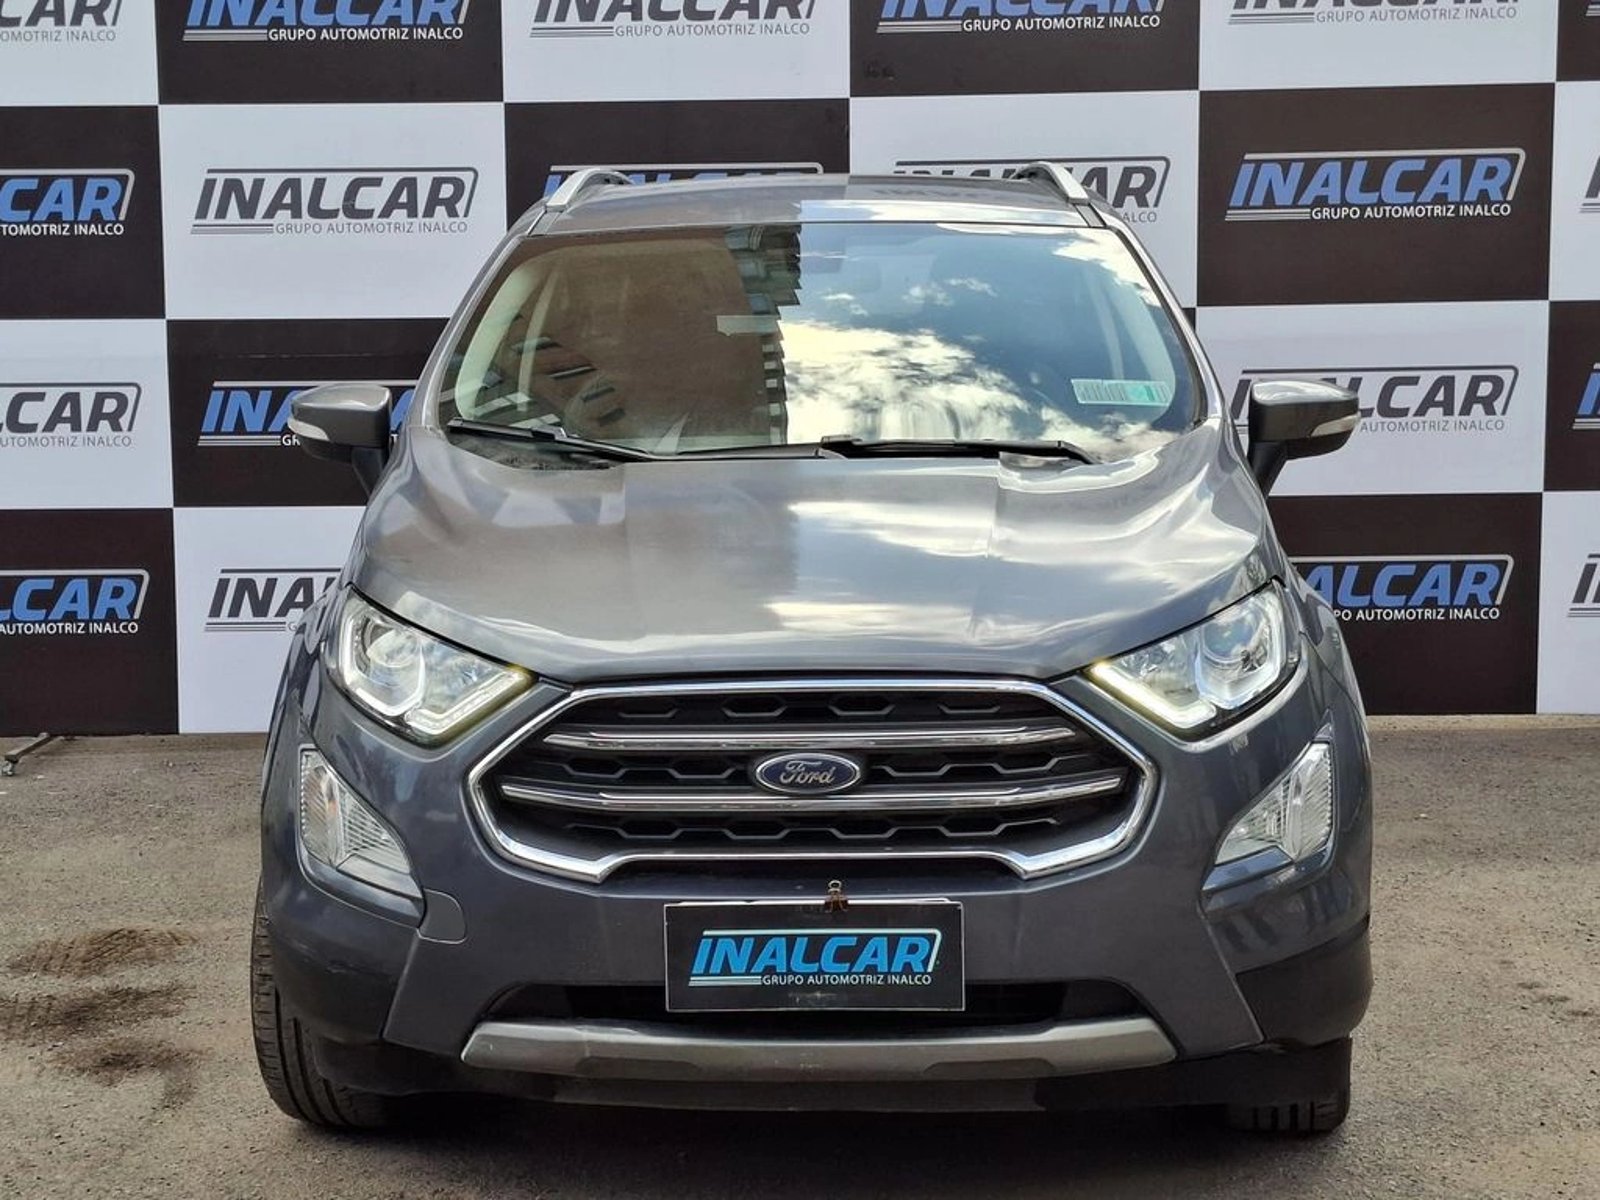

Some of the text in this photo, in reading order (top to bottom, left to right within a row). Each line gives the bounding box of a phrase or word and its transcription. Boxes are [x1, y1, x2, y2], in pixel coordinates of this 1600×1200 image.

[1316, 7, 1517, 23] GRUPO AUTOMOTRIZ INALCO
[615, 23, 810, 37] GRUPO AUTOMOTRIZ INALCO
[963, 15, 1160, 32] GRUPO AUTOMOTRIZ INALCO
[66, 30, 116, 42] INALCO
[269, 27, 463, 41] GRUPO AUTOMOTRIZ INALCO
[1230, 158, 1512, 207] INALCAR
[195, 177, 465, 220] INALCAR
[1312, 203, 1511, 220] GRUPO AUTOMOTRIZ INALCO
[75, 223, 124, 236] INALCO
[276, 220, 467, 234] GRUPO AUTOMOTRIZ INALCO
[1360, 418, 1504, 433] AUTOMOTRIZ INALCO
[83, 435, 132, 447] INALCO
[1356, 609, 1444, 621] AUTOMOTRIZ
[1449, 607, 1499, 620] INALCO
[90, 621, 138, 634] INALCO
[780, 761, 836, 783] Ford
[692, 936, 930, 974] INALCAR
[762, 974, 931, 986] GRUPO AUTOMOTRIZ INALCO
